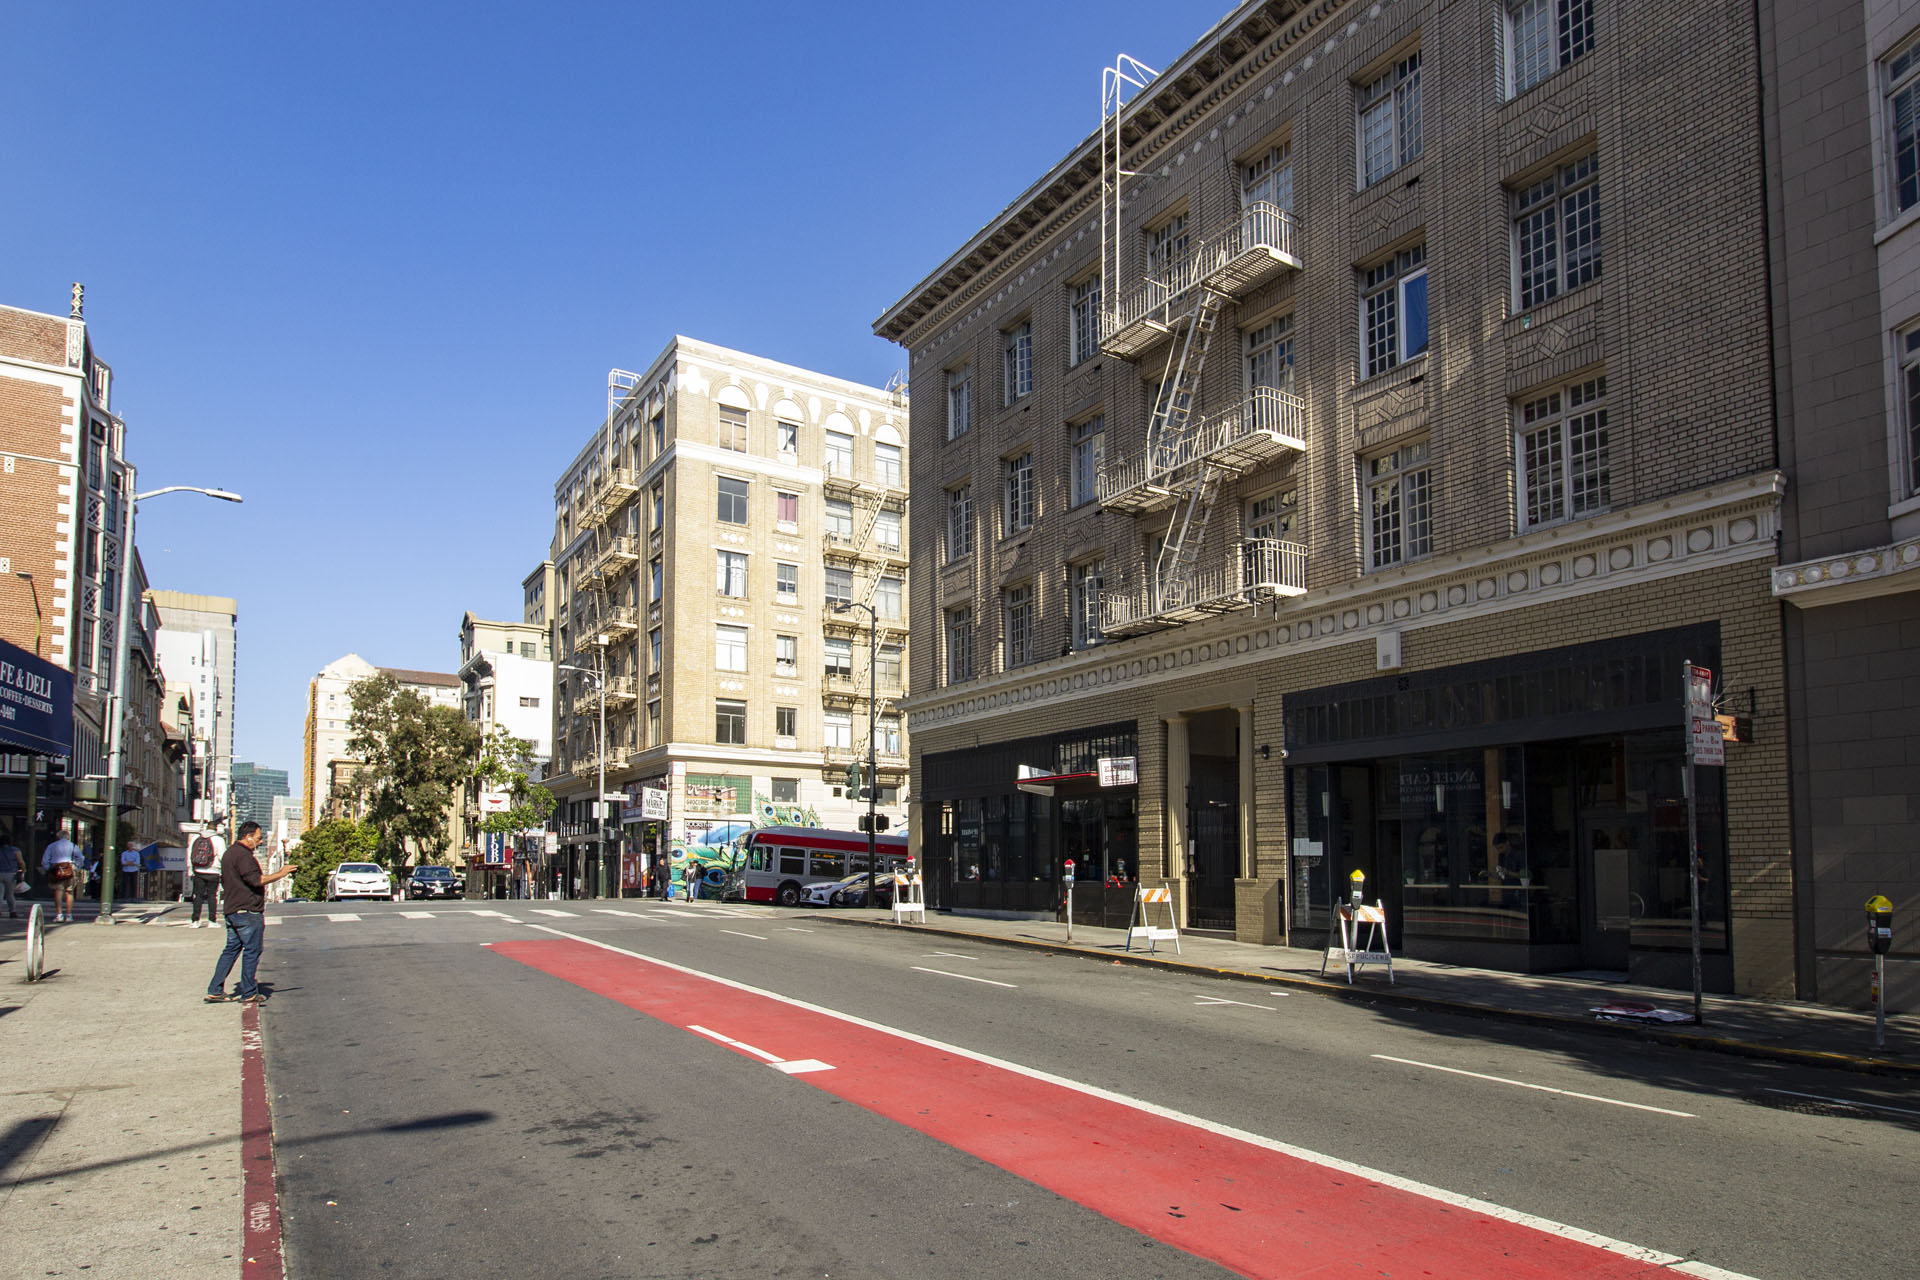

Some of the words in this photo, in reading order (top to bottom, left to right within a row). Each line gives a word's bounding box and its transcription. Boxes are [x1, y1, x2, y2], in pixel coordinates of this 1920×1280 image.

[16, 668, 24, 689] &
[25, 671, 53, 700] DELI
[1702, 723, 1721, 733] PARKING
[645, 798, 667, 810] MARKET
